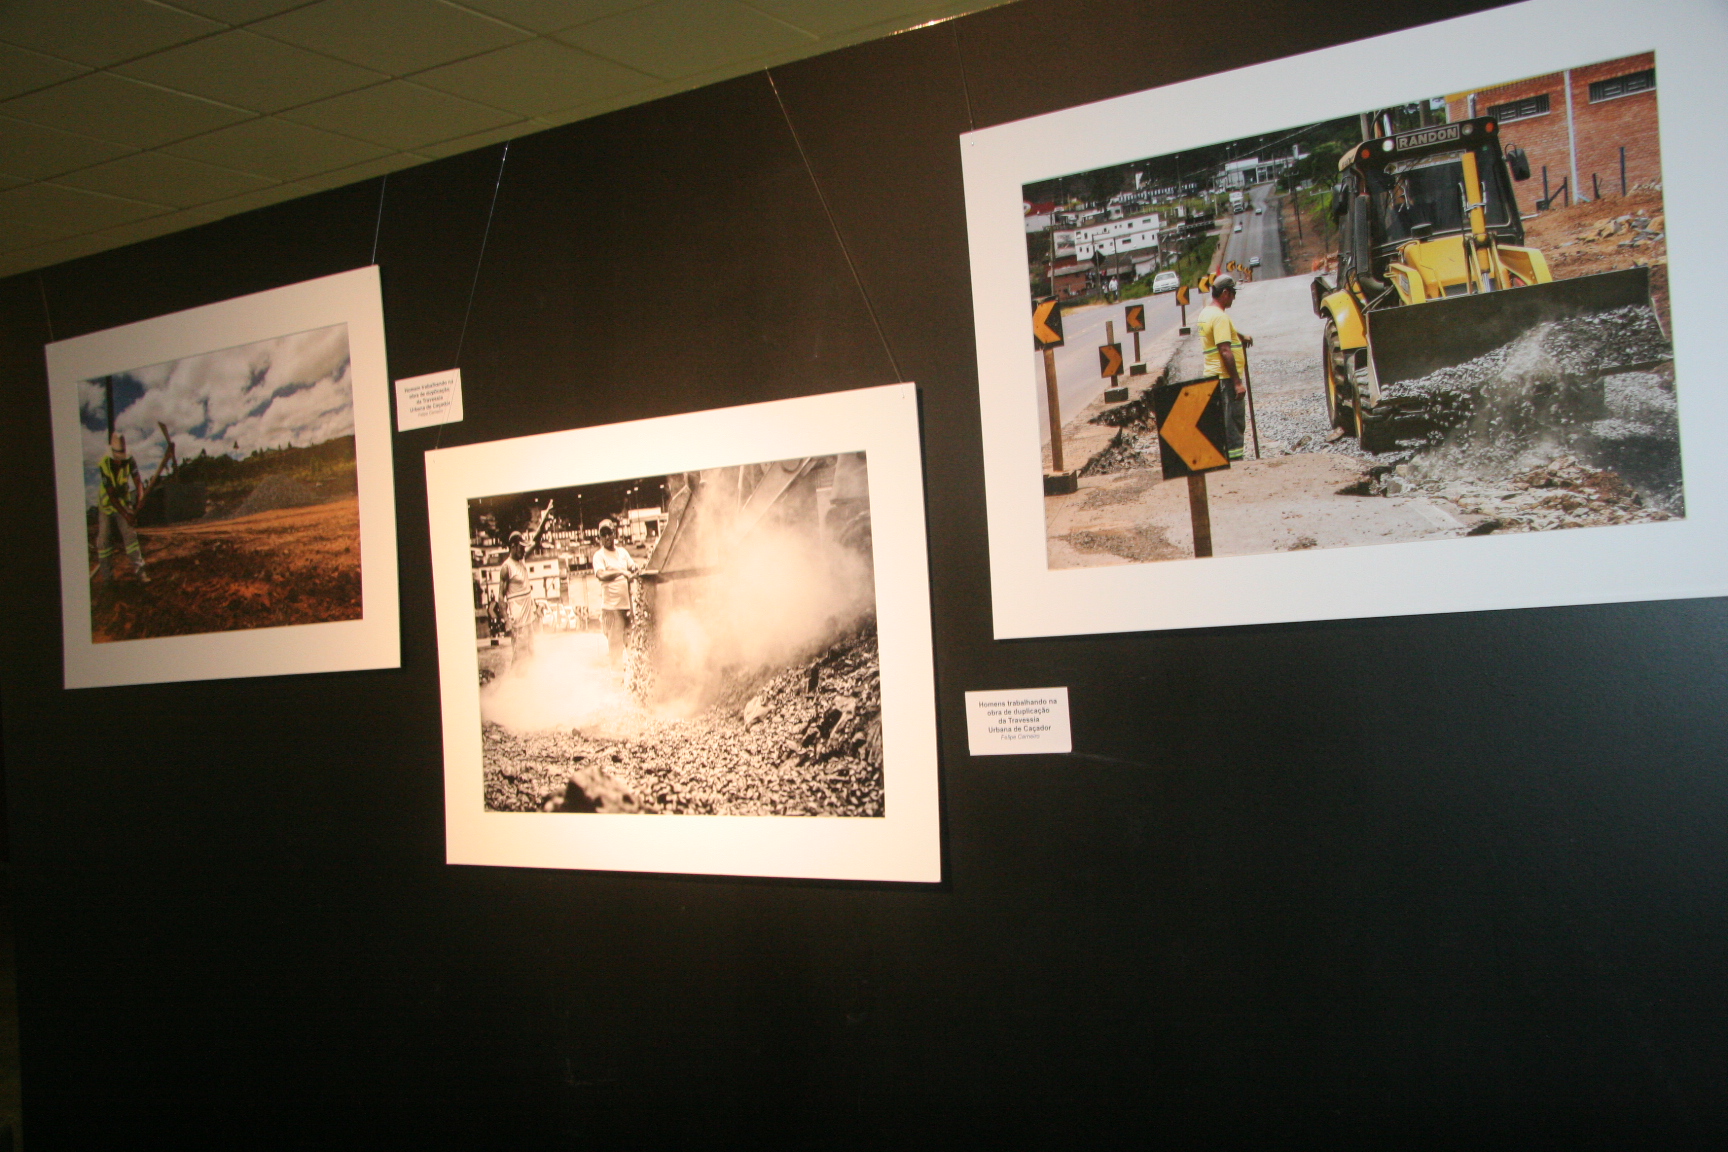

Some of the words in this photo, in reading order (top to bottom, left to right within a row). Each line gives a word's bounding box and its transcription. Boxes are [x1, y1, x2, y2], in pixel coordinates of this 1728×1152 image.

[1399, 127, 1457, 148] RANDON
[979, 700, 1006, 708] Homens
[1007, 698, 1047, 707] trabalhando
[1013, 707, 1050, 717] duplicação
[1007, 716, 1040, 724] Travessia
[1023, 724, 1051, 733] Caçador
